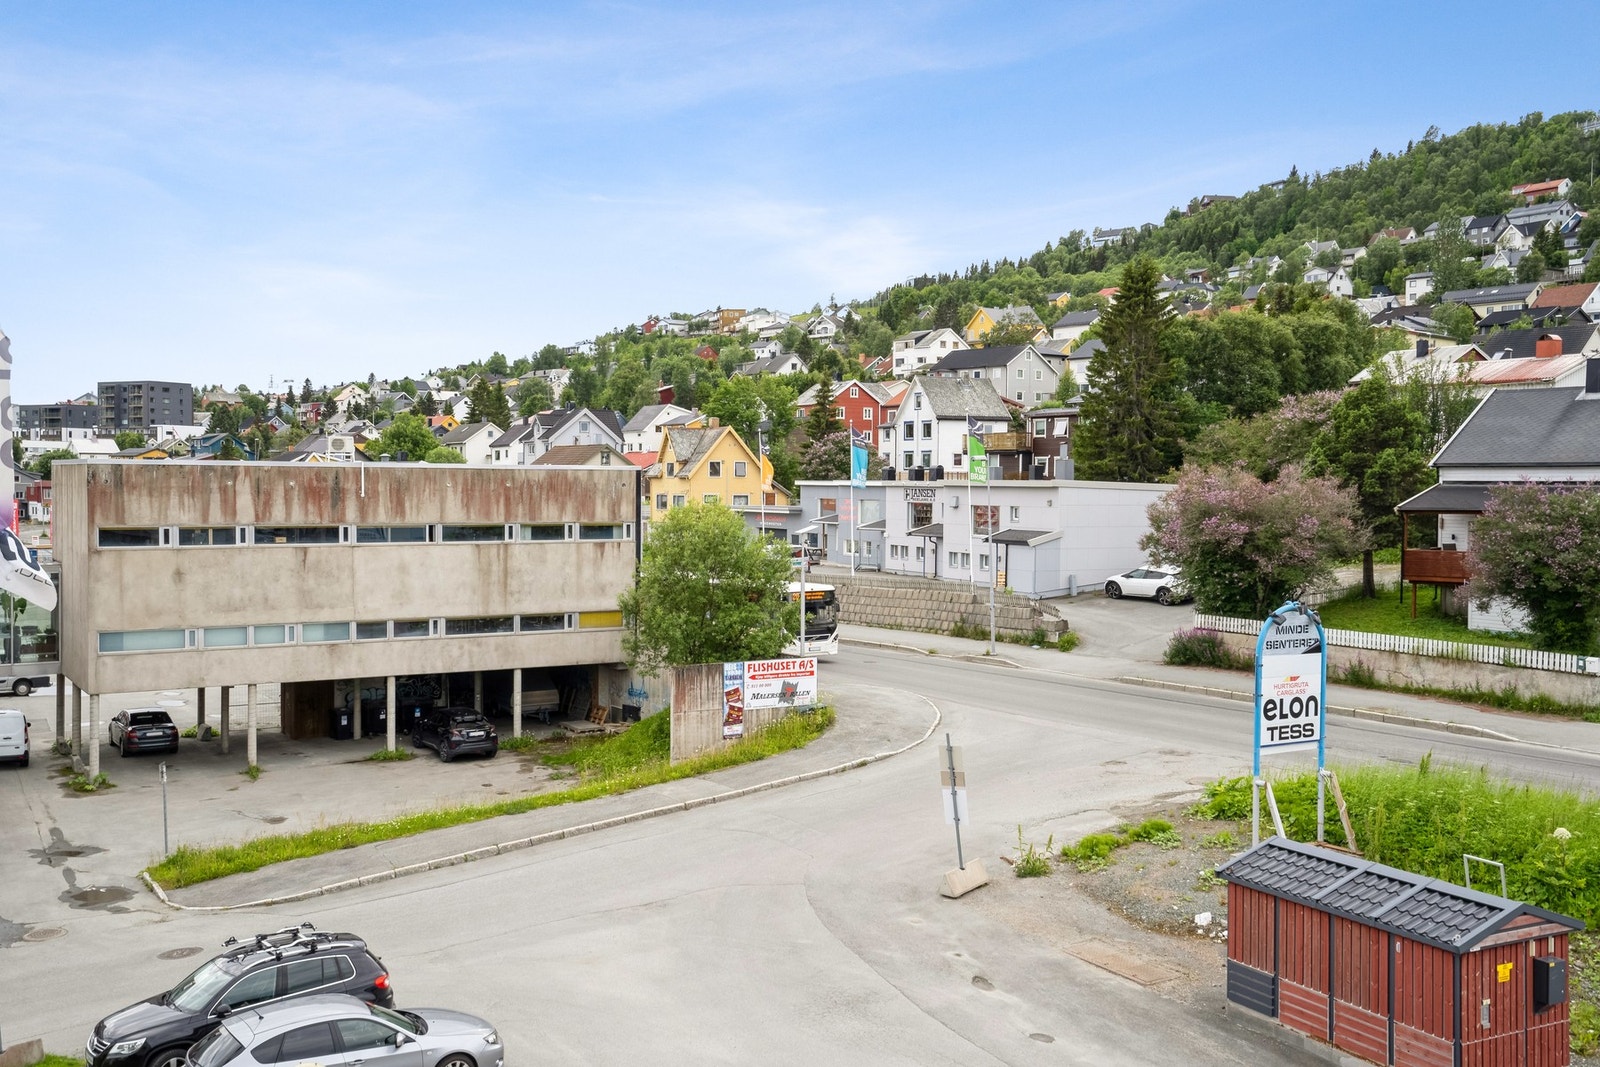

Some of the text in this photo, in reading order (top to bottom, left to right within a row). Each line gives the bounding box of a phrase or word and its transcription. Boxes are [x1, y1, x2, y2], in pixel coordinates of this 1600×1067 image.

[911, 489, 936, 499] JANSEN
[1275, 624, 1309, 636] MINDE
[747, 661, 797, 674] FLISHUSET
[799, 660, 815, 671] A/S
[1273, 682, 1309, 690] HURTIGRUTA
[1276, 688, 1307, 697] CARGLASS
[1266, 723, 1315, 741] TESS
